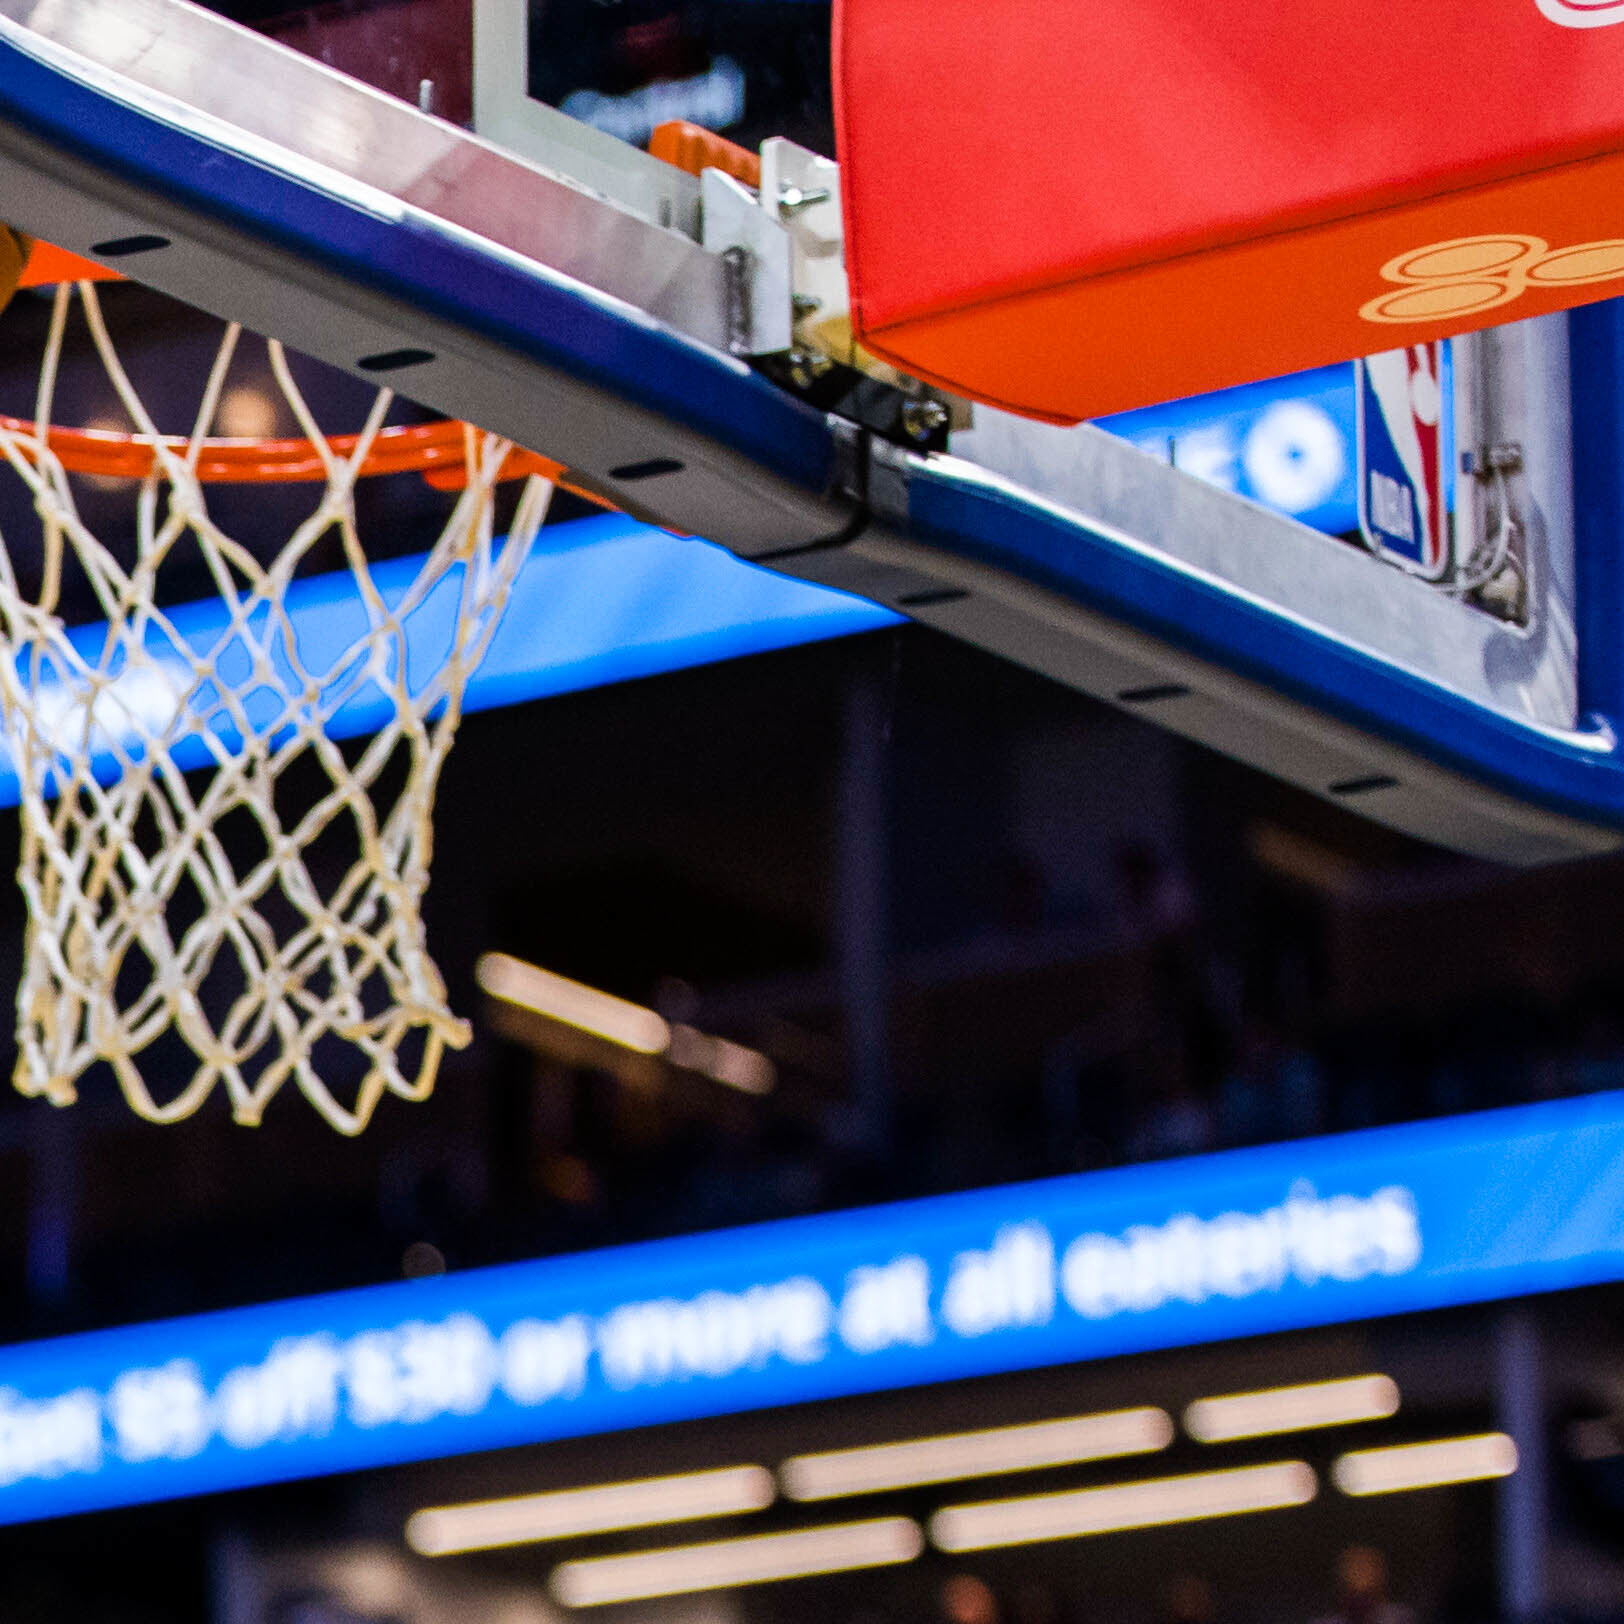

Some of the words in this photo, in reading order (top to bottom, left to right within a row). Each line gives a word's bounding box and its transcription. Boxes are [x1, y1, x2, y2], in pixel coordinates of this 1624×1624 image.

[498, 1314, 592, 1405] or
[598, 1276, 831, 1389] more
[839, 1254, 934, 1354] at
[942, 1220, 1054, 1336] all
[1061, 1177, 1423, 1320] eateries
